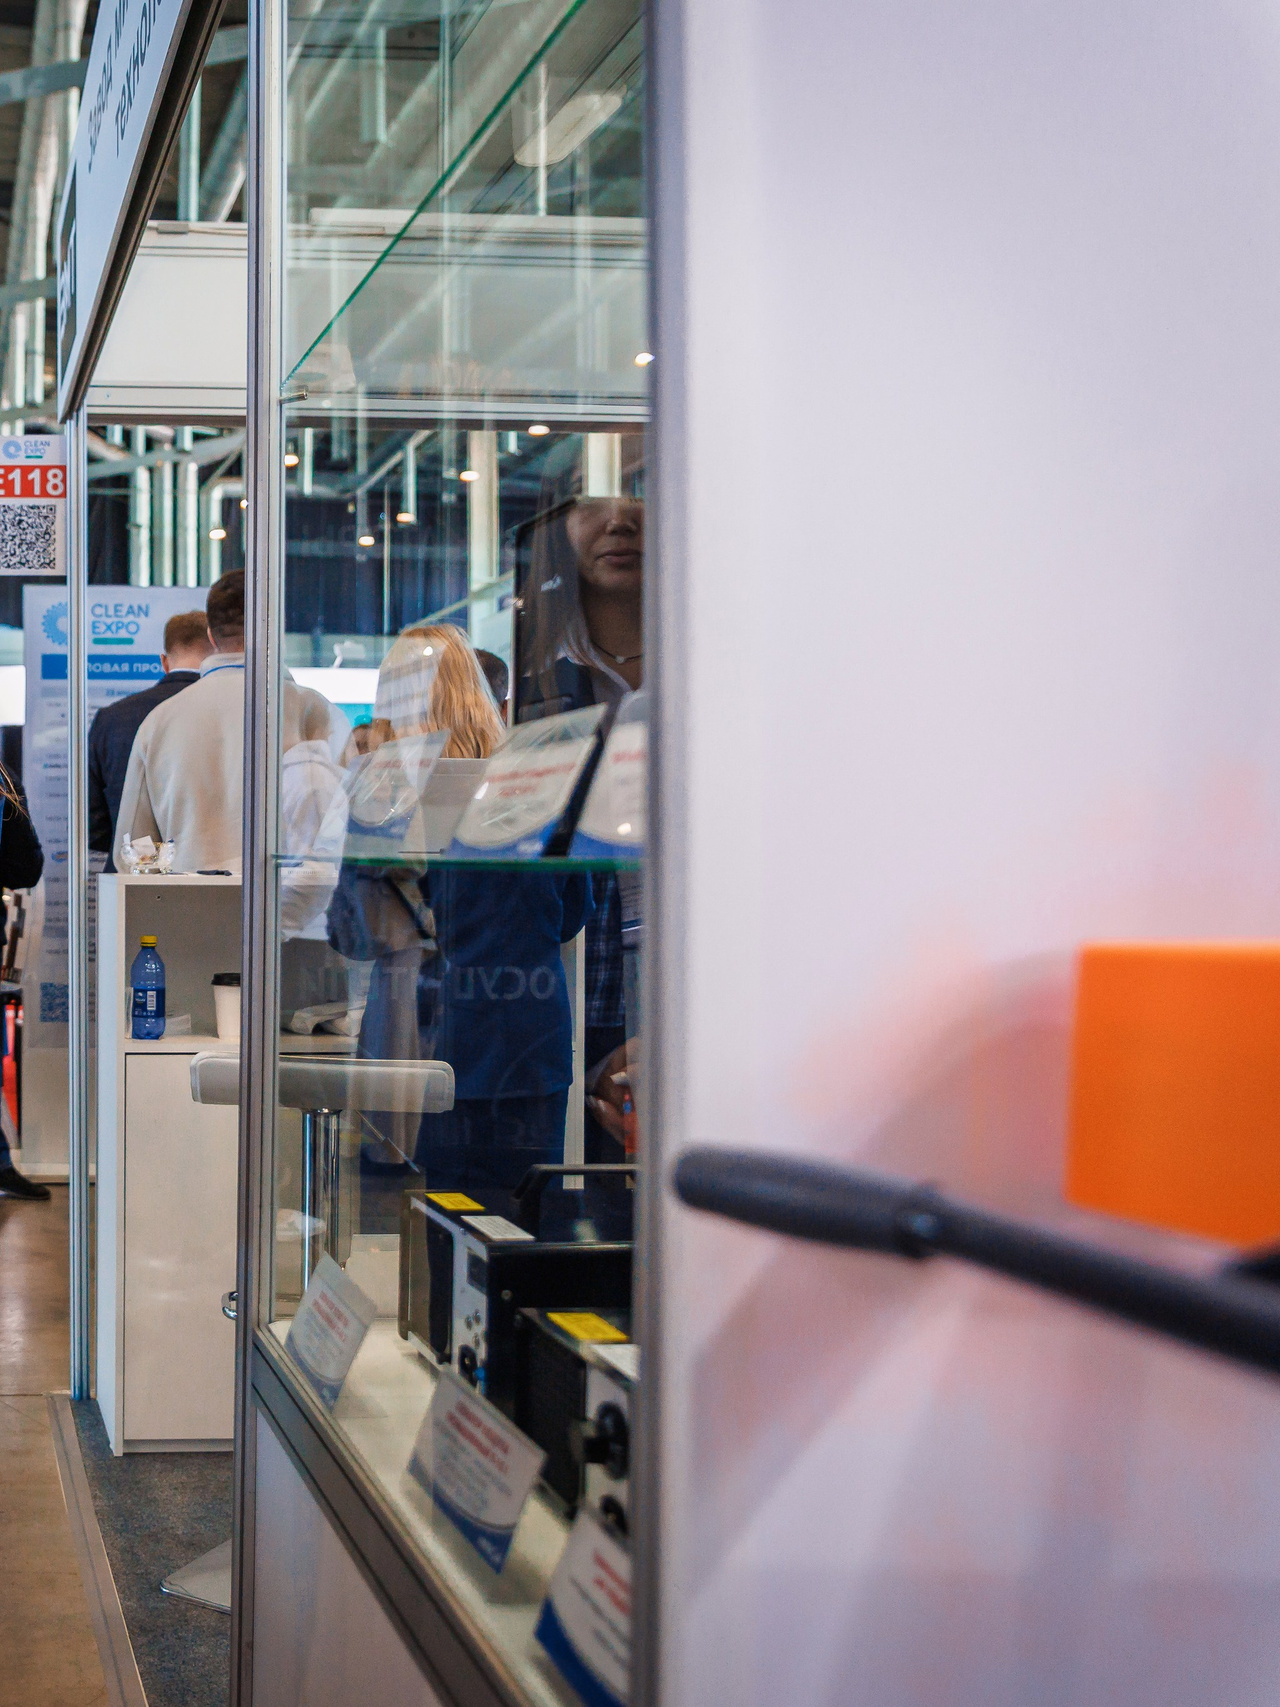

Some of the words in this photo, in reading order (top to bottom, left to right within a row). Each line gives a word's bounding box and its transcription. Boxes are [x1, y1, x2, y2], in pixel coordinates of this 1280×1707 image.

[23, 447, 46, 455] EXPO
[91, 603, 150, 618] CLEAN
[91, 620, 140, 635] EXPO
[133, 662, 164, 673] ПРО
